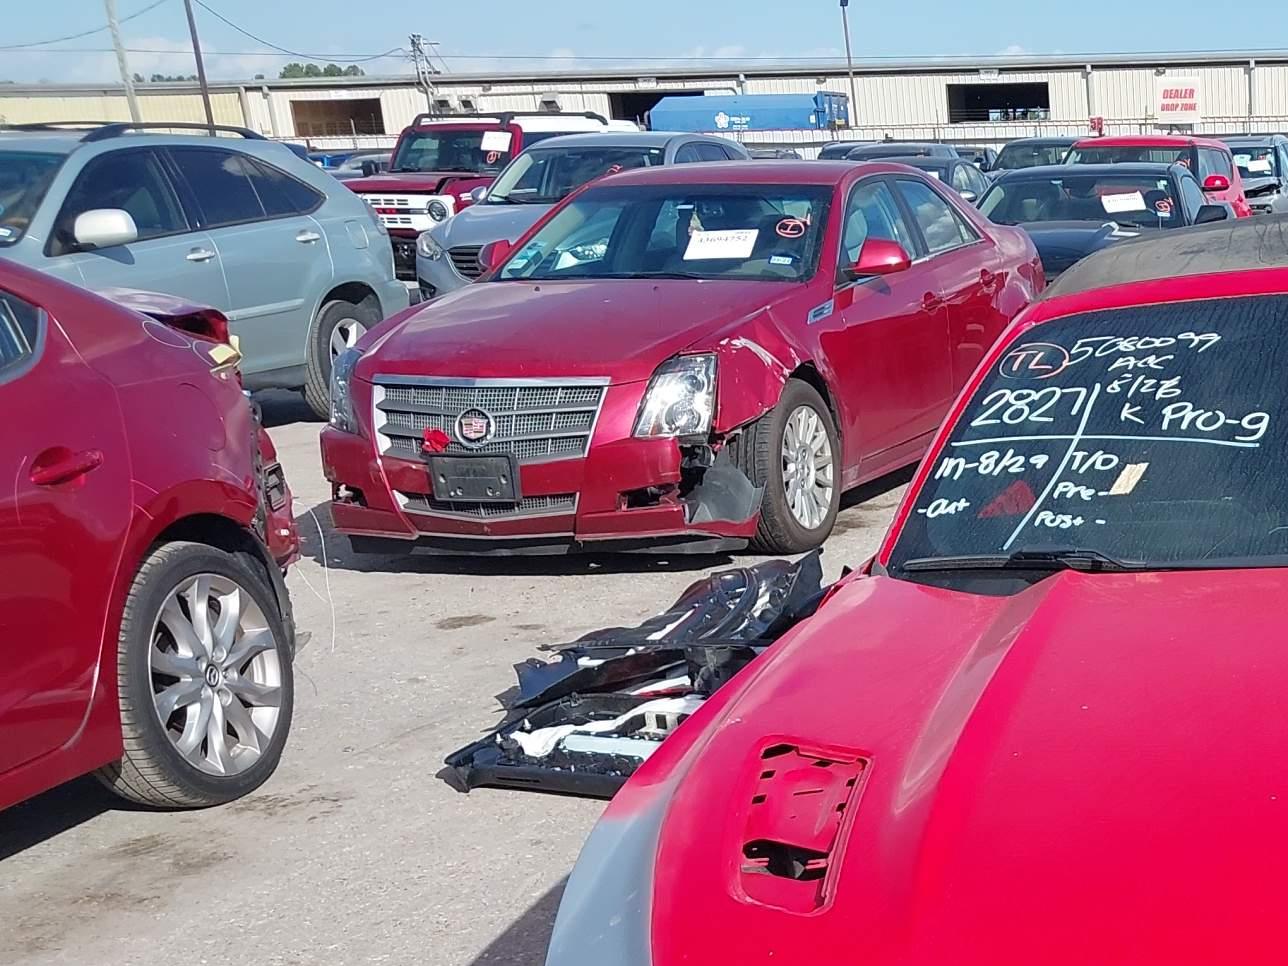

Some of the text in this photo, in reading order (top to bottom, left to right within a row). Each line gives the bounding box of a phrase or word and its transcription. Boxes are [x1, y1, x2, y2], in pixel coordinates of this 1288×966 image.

[1162, 88, 1195, 99] DEALER
[1160, 102, 1198, 111] DROP ZONE
[970, 386, 1088, 426] 2827
[1120, 402, 1145, 424] K
